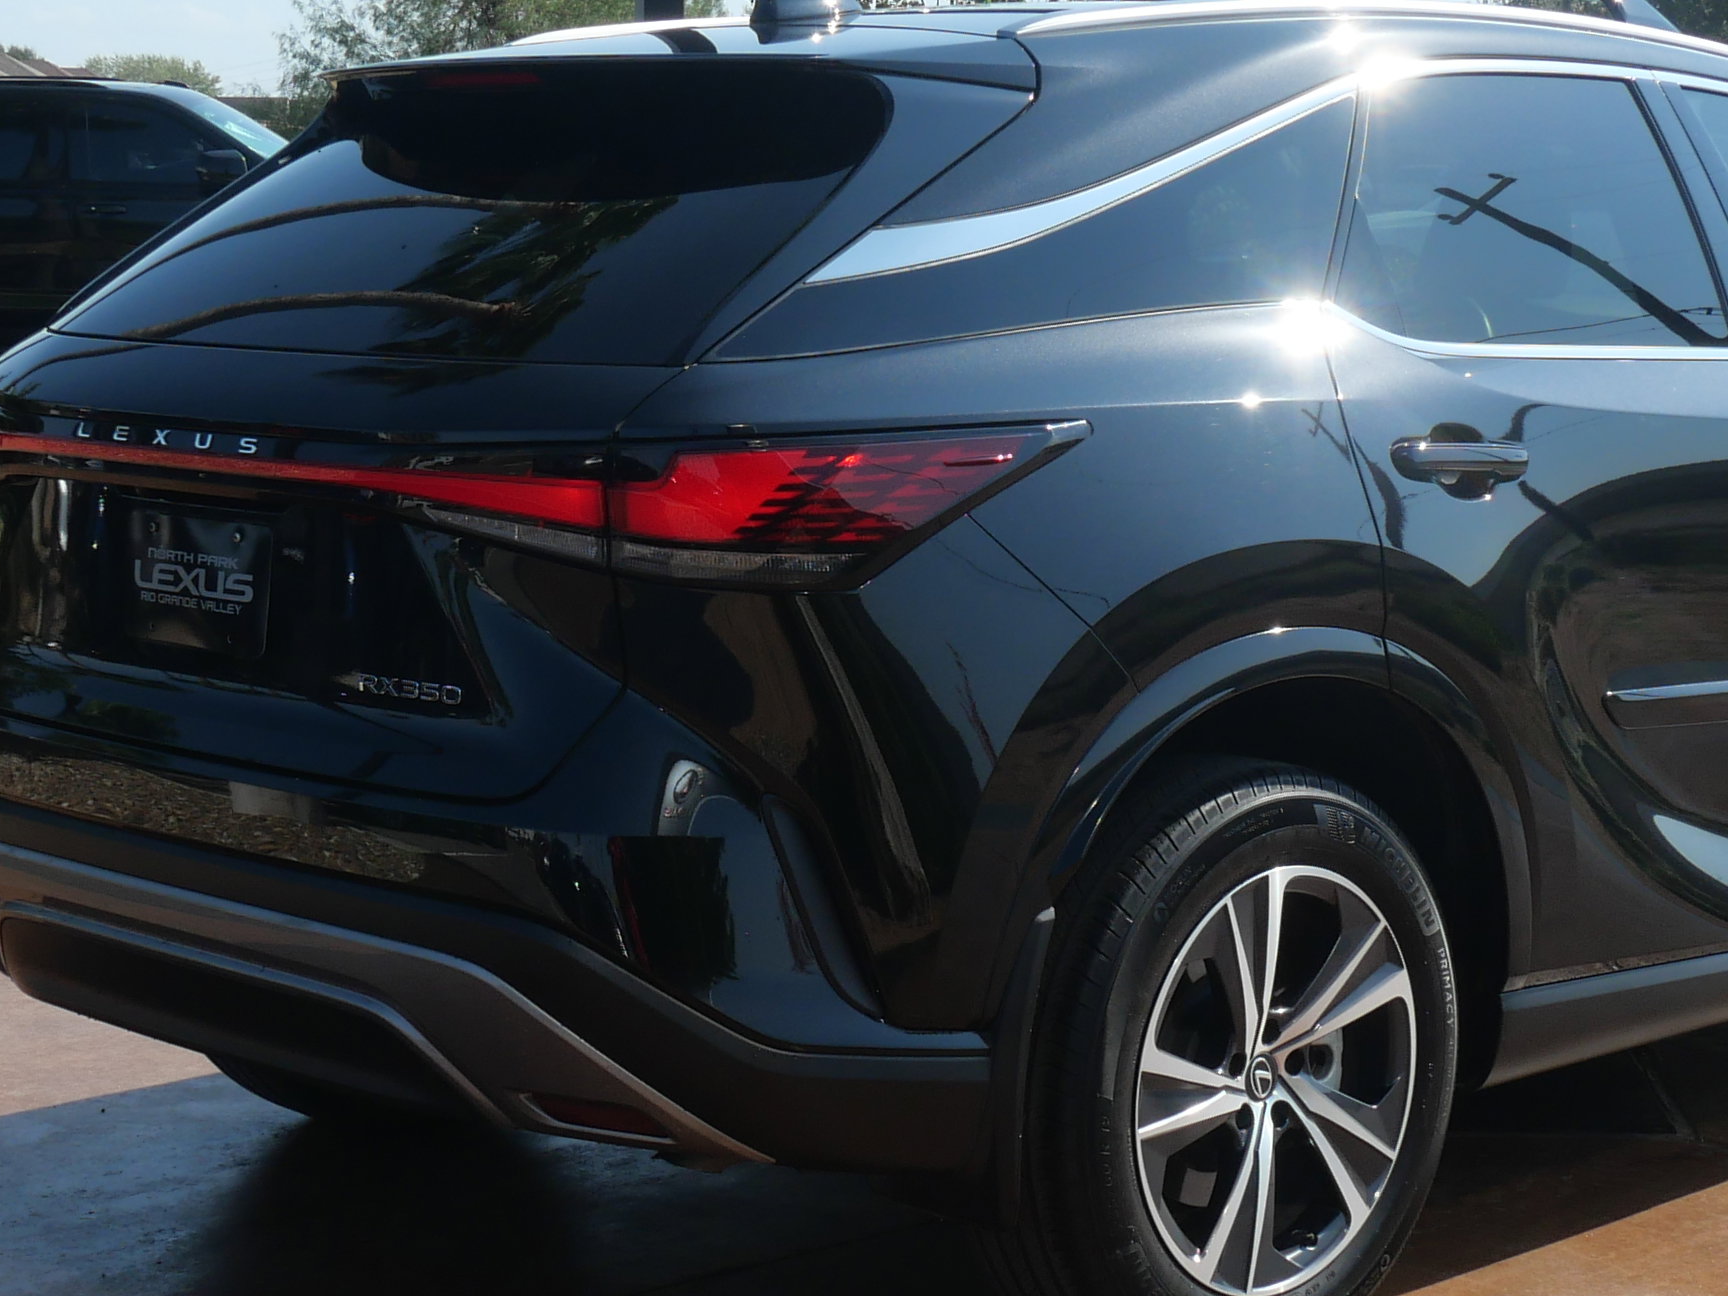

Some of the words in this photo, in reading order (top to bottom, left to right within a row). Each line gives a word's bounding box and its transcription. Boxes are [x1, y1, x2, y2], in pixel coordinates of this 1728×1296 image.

[77, 421, 259, 454] LEXUS
[147, 547, 194, 563] NORTH
[197, 553, 240, 570] PARK
[134, 559, 254, 603] LEXUS
[140, 590, 157, 603] RIO
[157, 593, 198, 609] GRANDE
[200, 600, 242, 615] VALLEY
[1437, 947, 1455, 1029] PRIMACY
